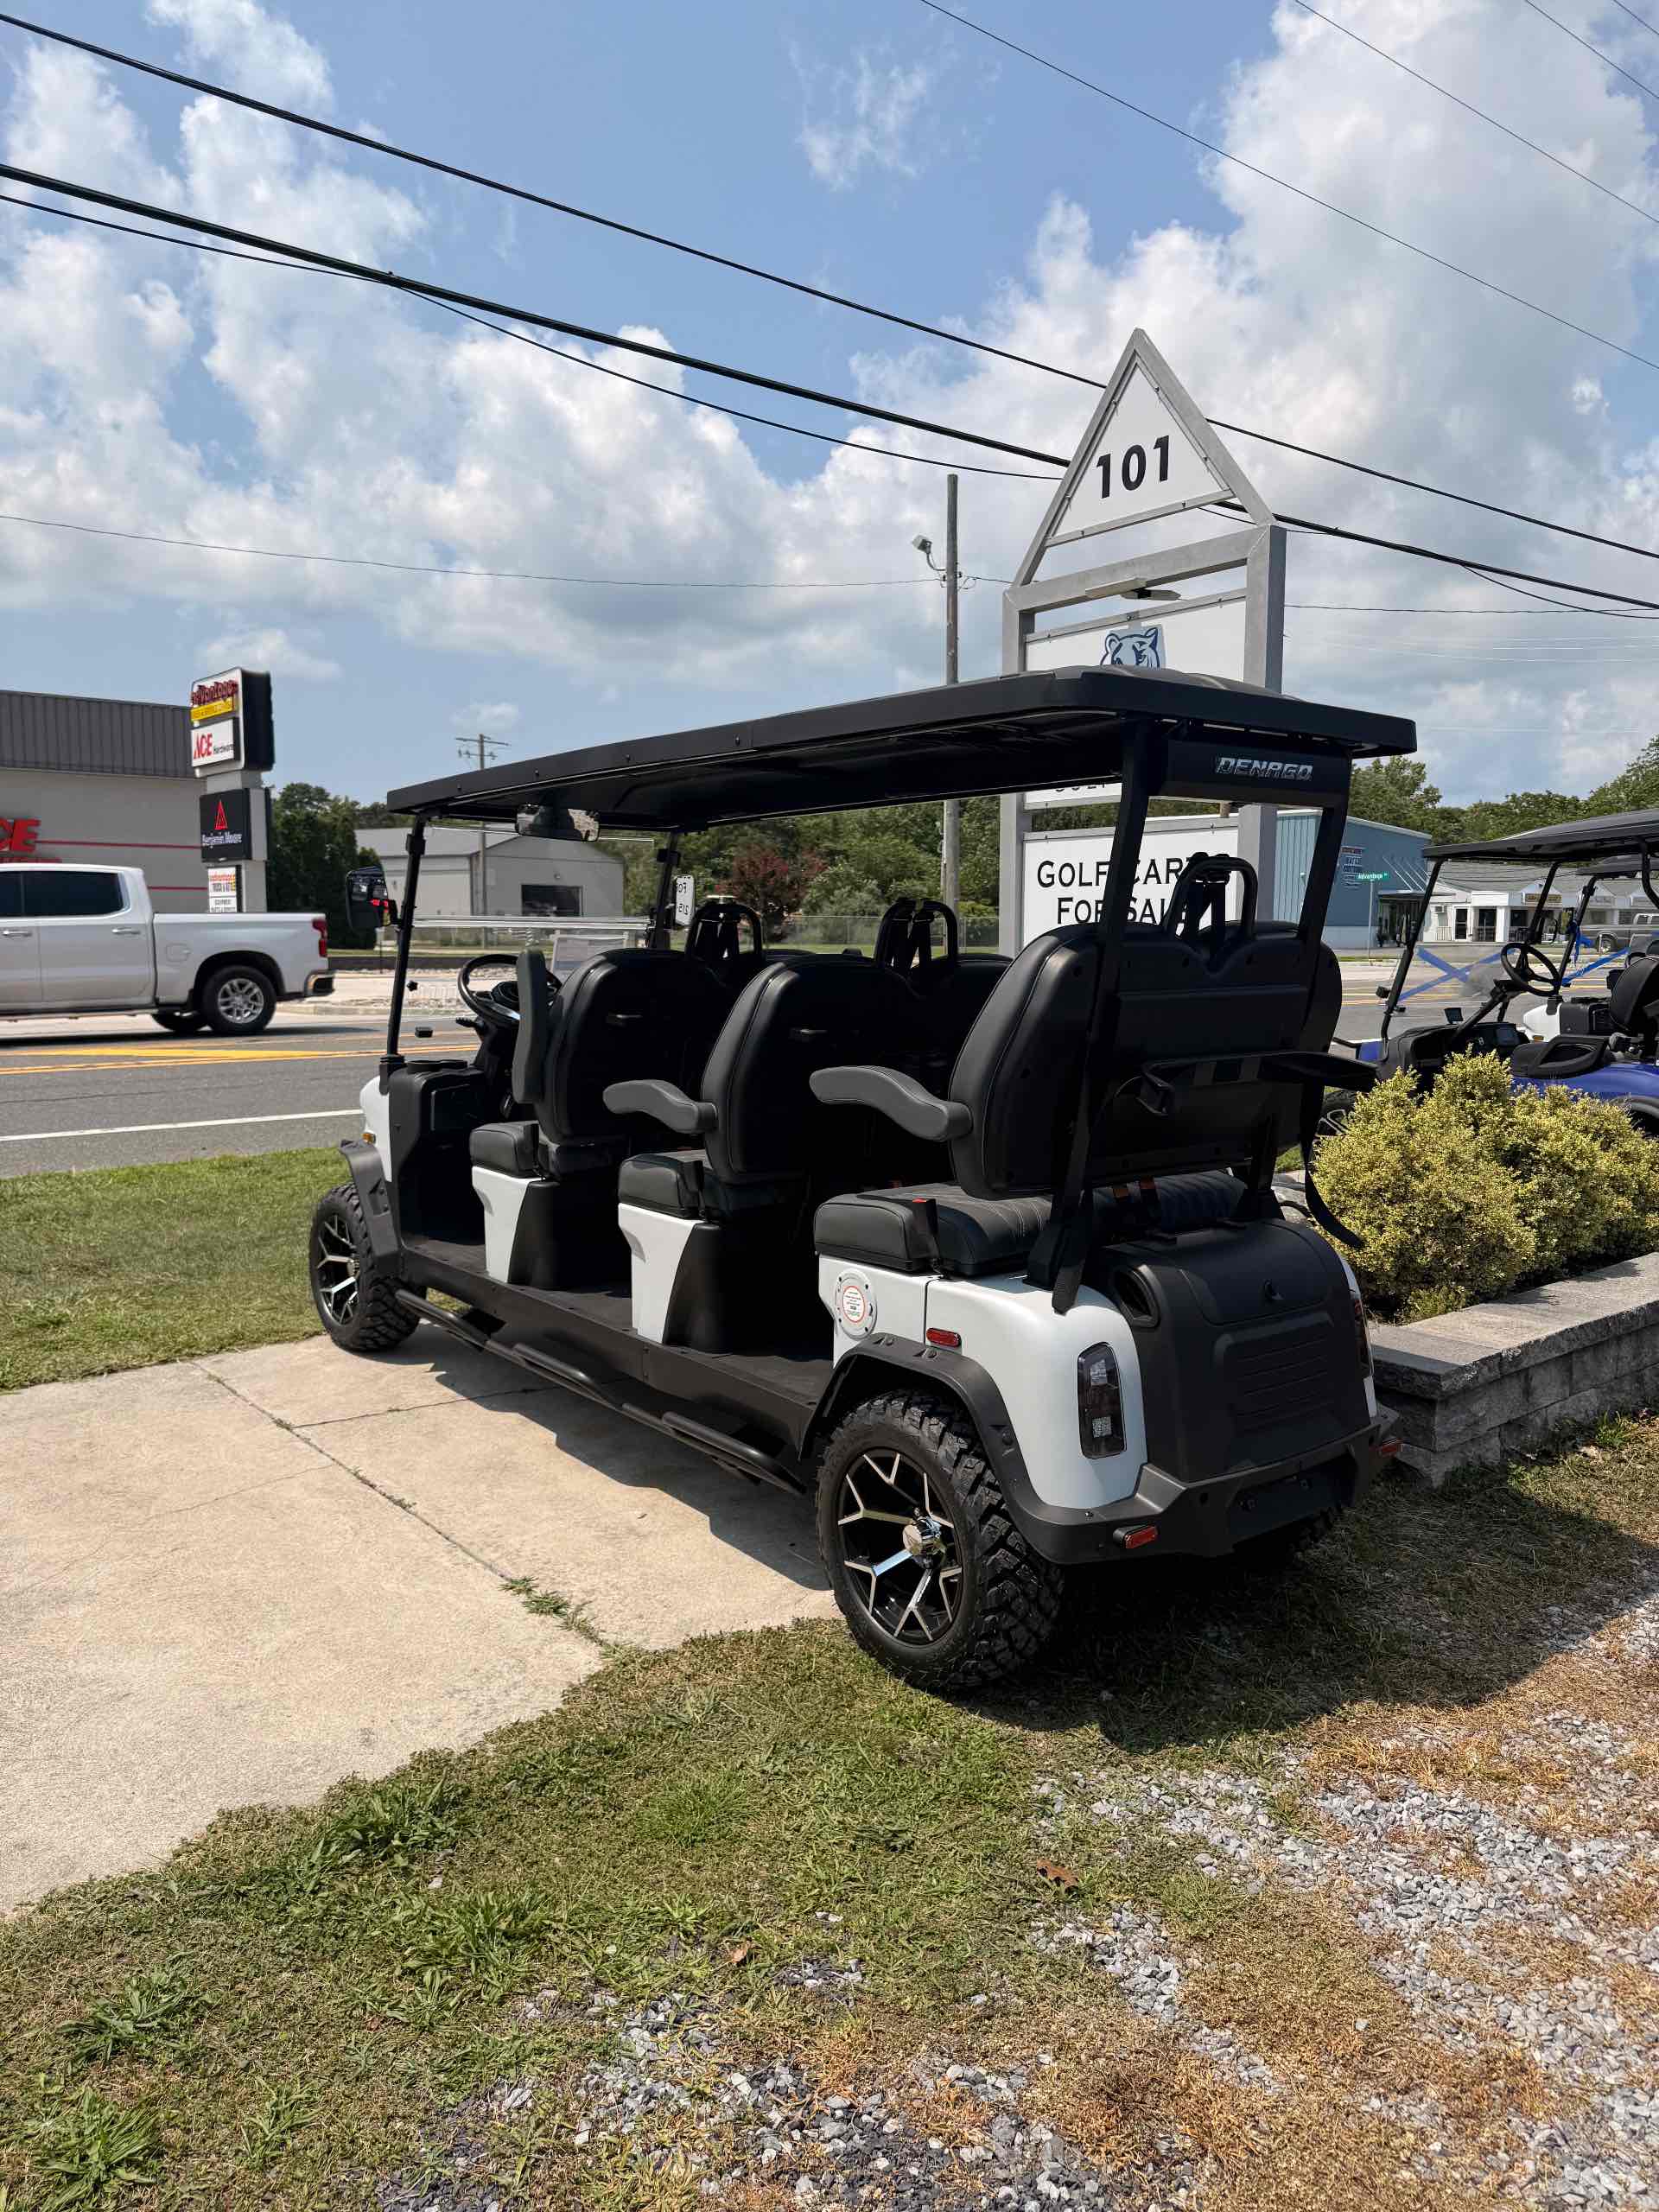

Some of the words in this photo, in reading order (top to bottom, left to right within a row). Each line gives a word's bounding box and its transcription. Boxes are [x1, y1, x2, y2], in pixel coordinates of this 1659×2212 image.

[1096, 435, 1169, 499] 101
[194, 733, 213, 760] ACE
[1217, 757, 1313, 779] DENAGO
[1037, 860, 1109, 888] GOLF
[1127, 897, 1172, 924] SAL
